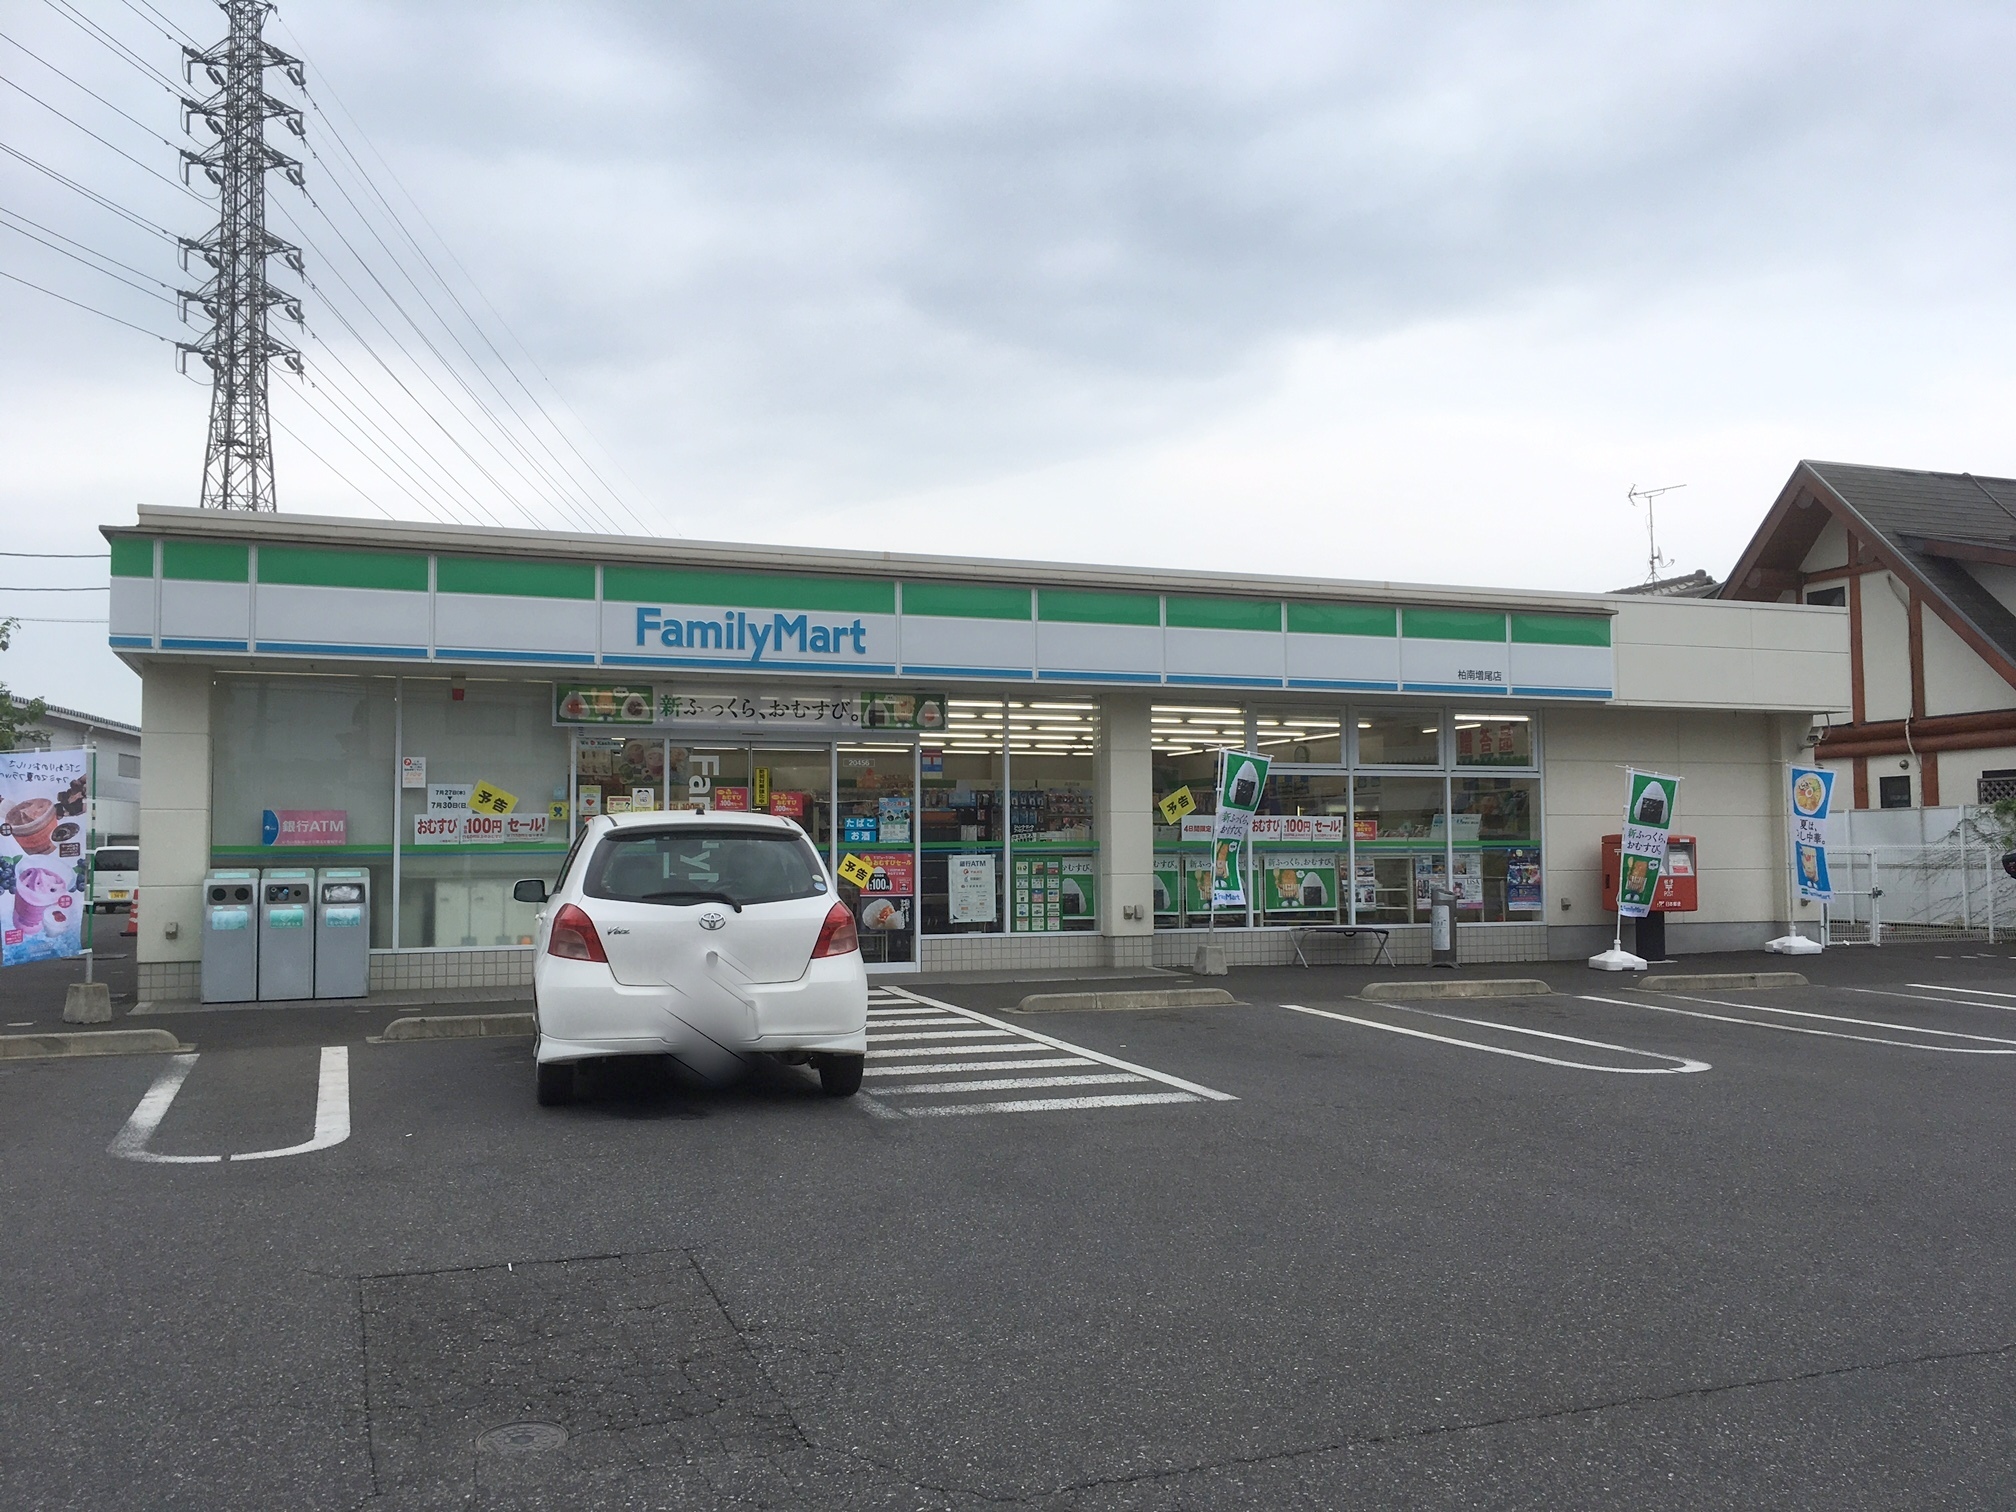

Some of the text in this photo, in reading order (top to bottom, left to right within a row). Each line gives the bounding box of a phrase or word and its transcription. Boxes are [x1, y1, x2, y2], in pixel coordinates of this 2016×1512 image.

[636, 607, 866, 661] FamilyMart
[1457, 669, 1502, 681] 柏南増尾店
[478, 789, 508, 813] 予告
[1166, 794, 1190, 816] 予告
[282, 820, 344, 833] 銀行ATM
[416, 818, 458, 835] おむすび
[846, 818, 874, 828] たばこ
[1251, 818, 1280, 833] おむすび
[850, 831, 870, 841] お酒
[844, 860, 869, 881] 予告
[959, 860, 987, 868] 銀行ATM
